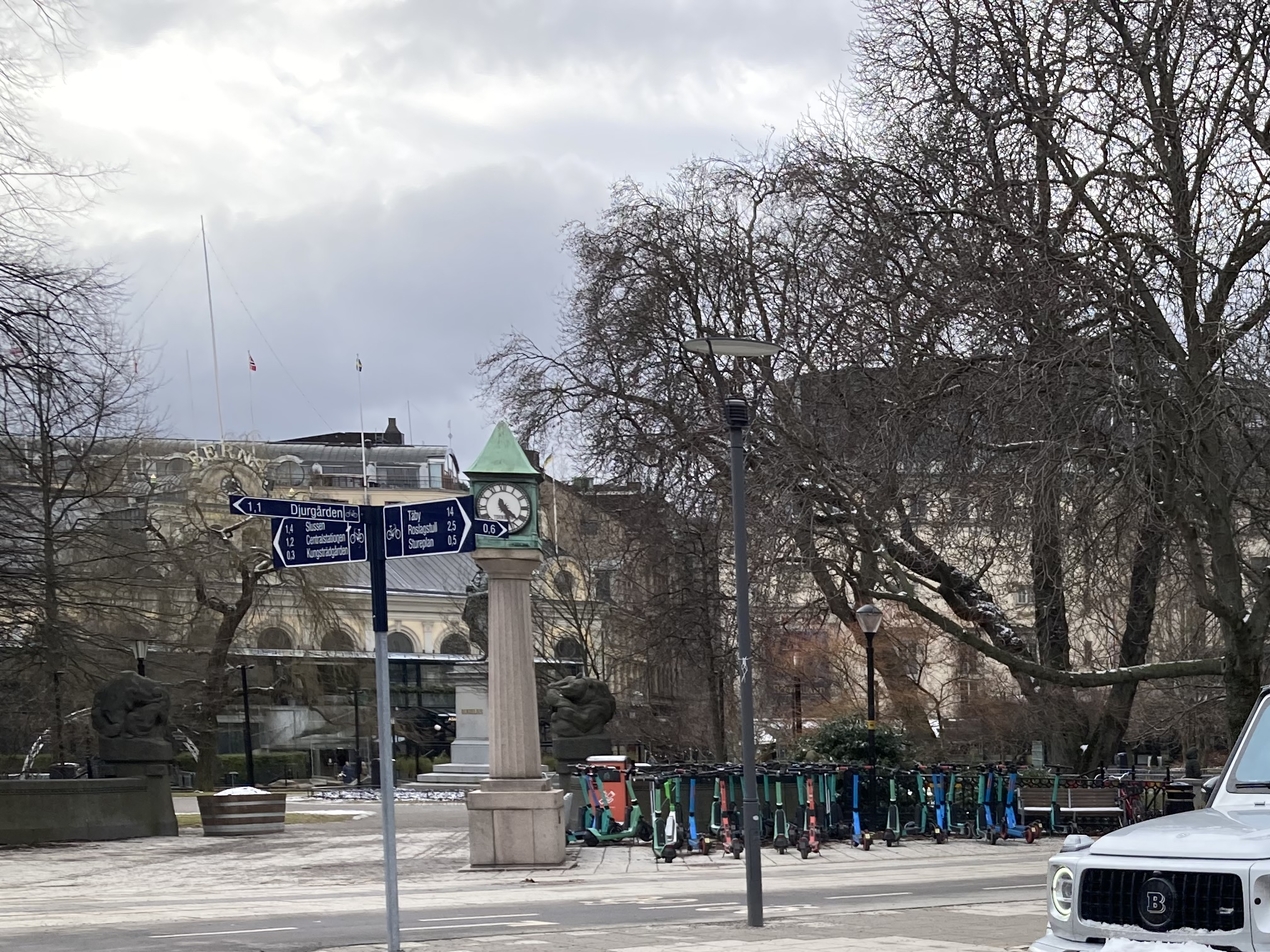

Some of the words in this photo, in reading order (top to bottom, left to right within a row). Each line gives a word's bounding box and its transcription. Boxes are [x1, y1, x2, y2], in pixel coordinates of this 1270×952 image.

[248, 501, 262, 513] 1,1
[290, 503, 343, 519] Djurgården
[407, 510, 421, 522] Täby
[446, 507, 454, 517] 14
[285, 524, 294, 534] 1,4
[305, 521, 325, 532] Slussen
[407, 521, 438, 536] Roslagstull
[447, 521, 457, 532] 2,5
[482, 523, 496, 535] 0,6
[286, 537, 295, 548] 1,2
[305, 533, 346, 545] Centralstationen
[408, 537, 434, 550] Stureplan
[447, 535, 457, 546] 0,5
[286, 550, 296, 561] 0,3
[306, 546, 349, 560] Kungsträdgården
[1146, 892, 1166, 914] B
